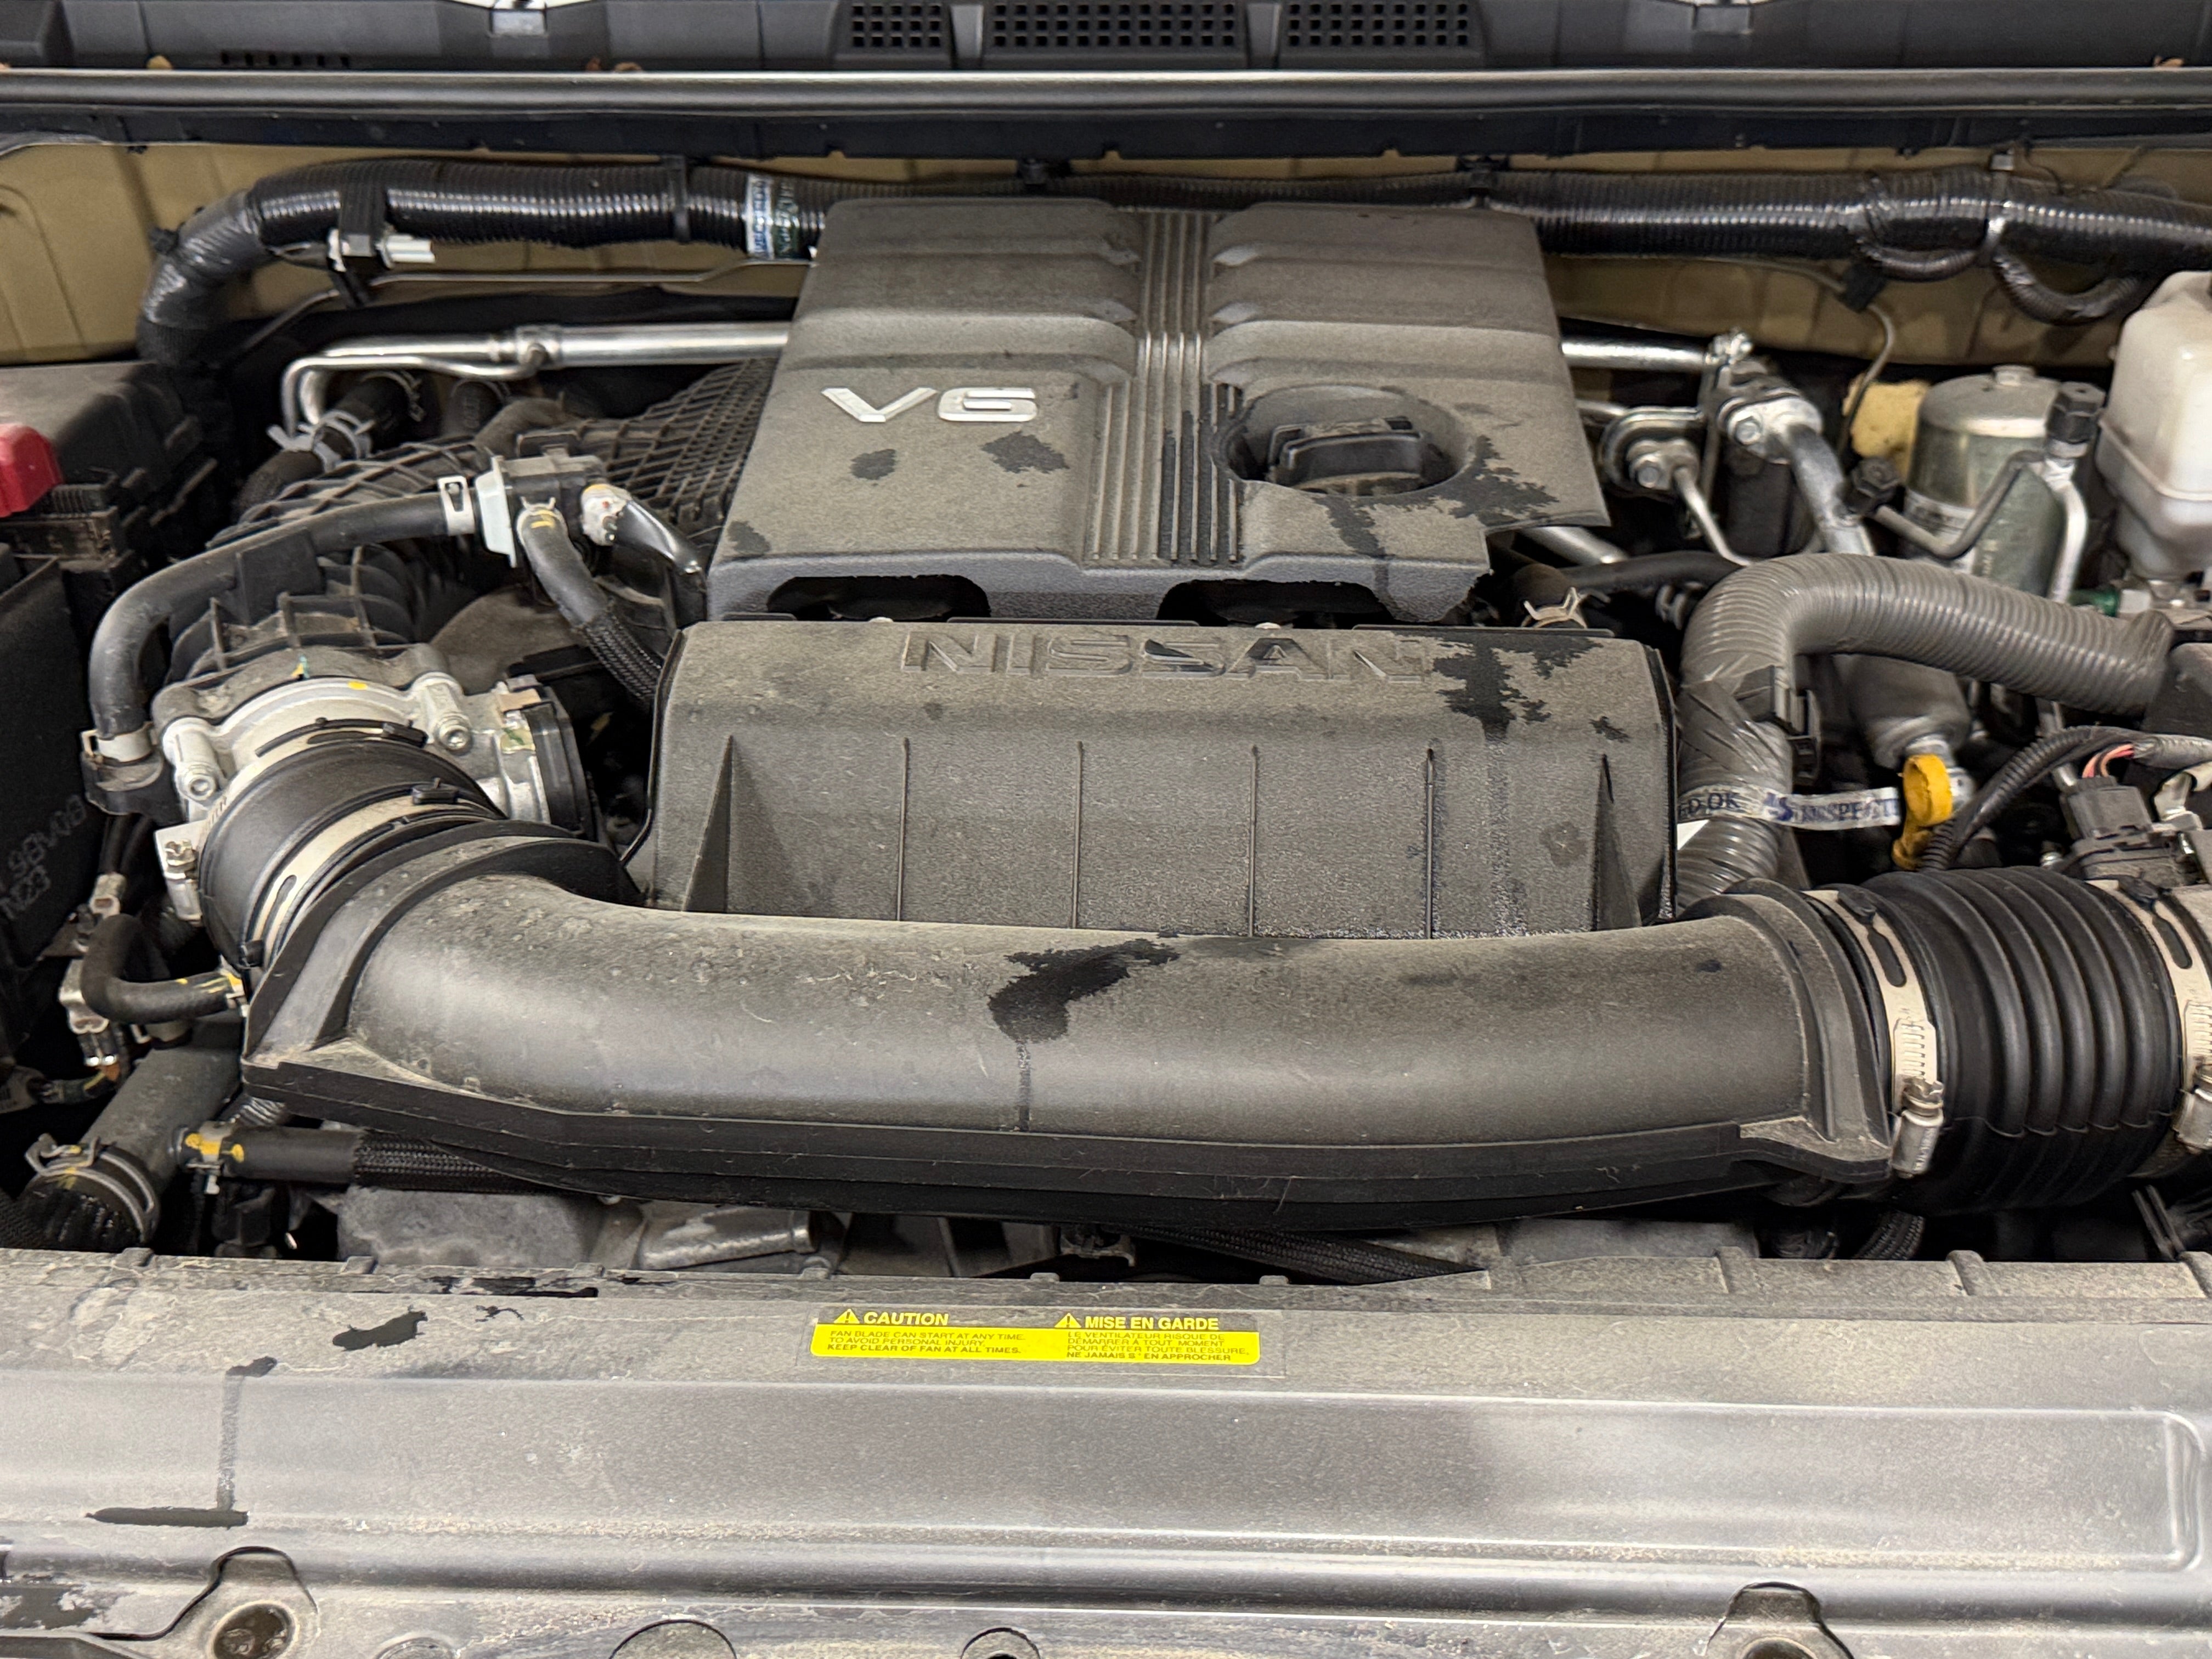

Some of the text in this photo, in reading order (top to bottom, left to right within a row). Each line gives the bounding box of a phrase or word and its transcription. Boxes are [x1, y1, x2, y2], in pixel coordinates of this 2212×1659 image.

[821, 387, 1037, 422] V6
[901, 629, 1429, 683] NISSAN
[863, 1311, 949, 1326] CAUTION
[1085, 1316, 1220, 1330] MISE EN GARDE
